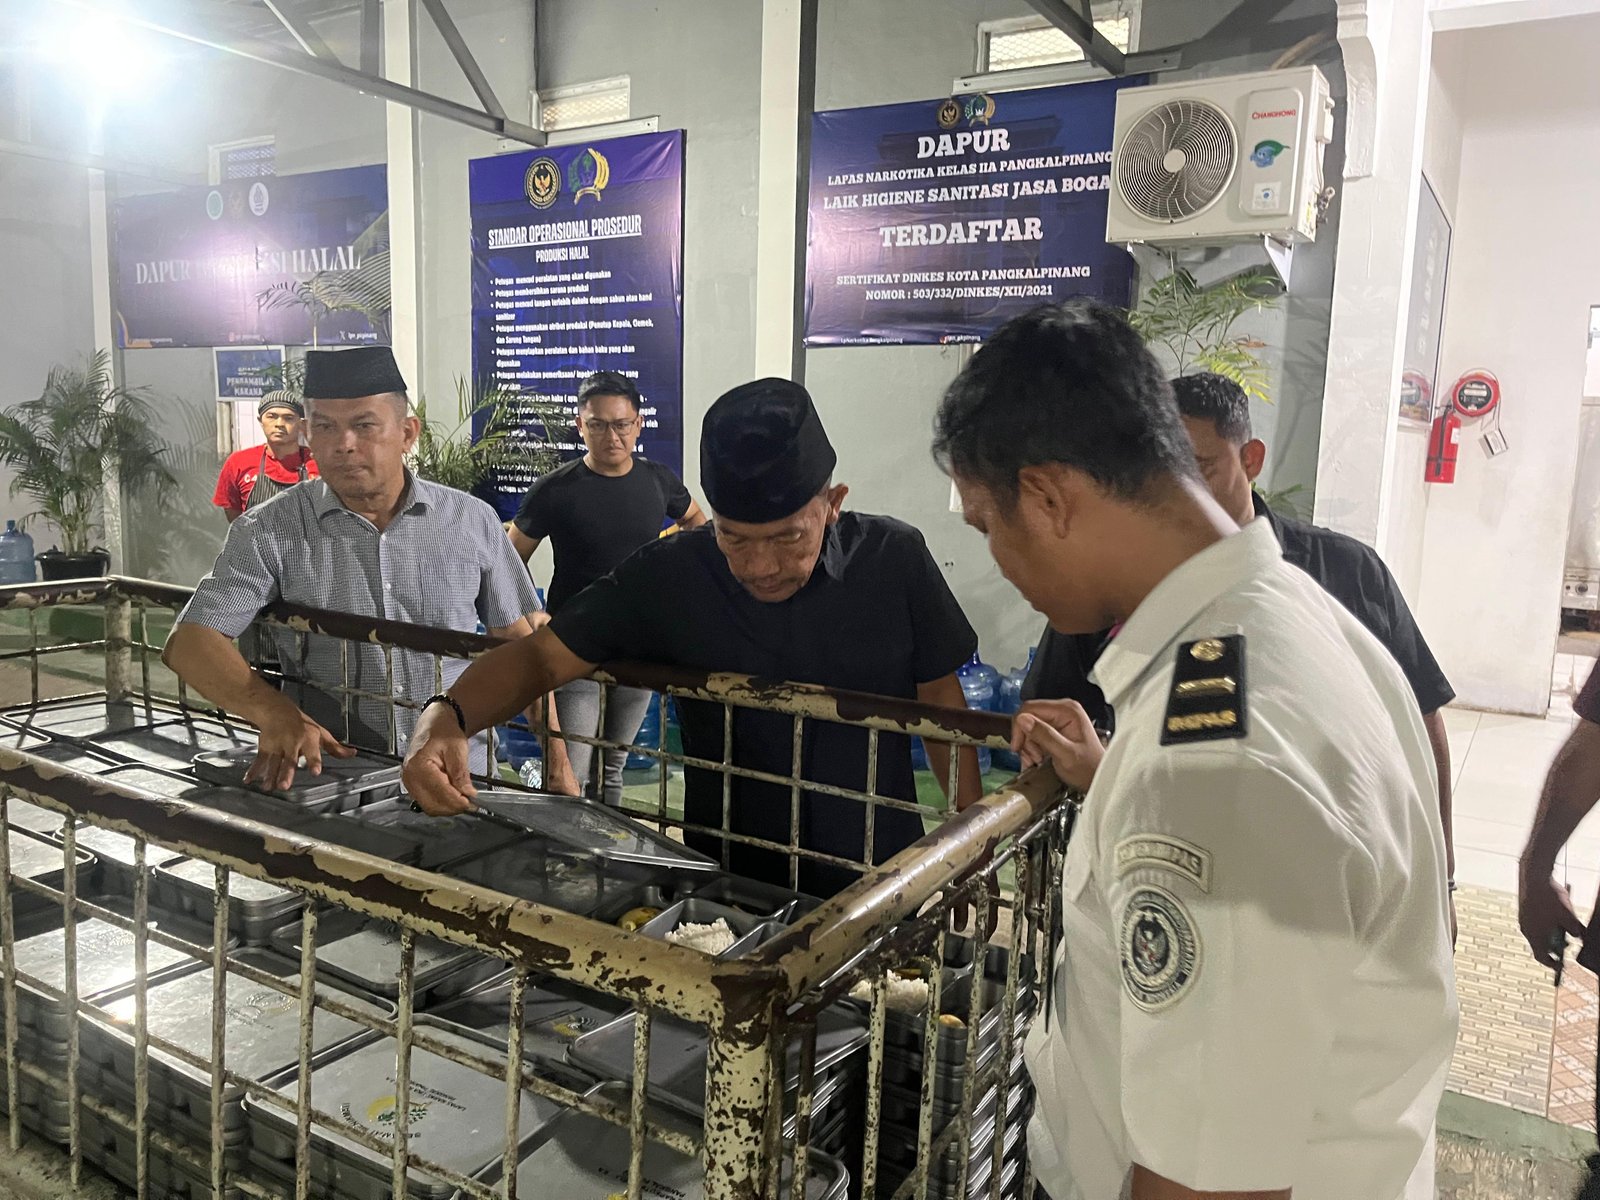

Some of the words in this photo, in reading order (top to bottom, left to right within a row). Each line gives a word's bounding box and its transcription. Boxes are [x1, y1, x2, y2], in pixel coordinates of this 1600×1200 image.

[1252, 109, 1296, 119] CHANGHONG
[917, 128, 1010, 158] DAPUR
[828, 171, 864, 186] LAPAS
[866, 166, 934, 183] NARKOTIKA
[937, 163, 977, 177] KELAS
[979, 162, 997, 174] IIA
[1000, 151, 1112, 172] PANGKALPINANG
[823, 194, 859, 210] LAIK
[862, 189, 925, 208] HIGIENE
[928, 183, 1009, 203] SANITASI
[1012, 180, 1057, 200] JASA
[1061, 174, 1111, 193] BOGA
[488, 226, 527, 246] STANDAR
[529, 219, 589, 242] OPERASIONAL
[591, 214, 642, 236] PROSEDUR
[879, 217, 1043, 247] TERDAFTAR
[536, 247, 568, 263] PRODUKSI
[569, 246, 589, 260] HALAL
[136, 259, 192, 284] DAPUR
[292, 245, 361, 273] HALAL
[585, 270, 611, 280] digunakan
[837, 273, 900, 286] SERTIFIKAT
[902, 271, 944, 283] DINKES
[946, 269, 979, 282] KOTA
[982, 266, 1091, 280] PANGKALPINANG
[567, 283, 589, 294] produksi
[639, 292, 652, 301] hand
[866, 289, 905, 300] NOMOR
[913, 284, 1053, 300] 503/332/DINKES/XII/2021
[496, 336, 505, 344] dan
[568, 345, 578, 354] dan
[579, 345, 594, 354] bahan
[595, 345, 608, 354] baku
[608, 345, 621, 354] yang
[622, 344, 635, 353] akan
